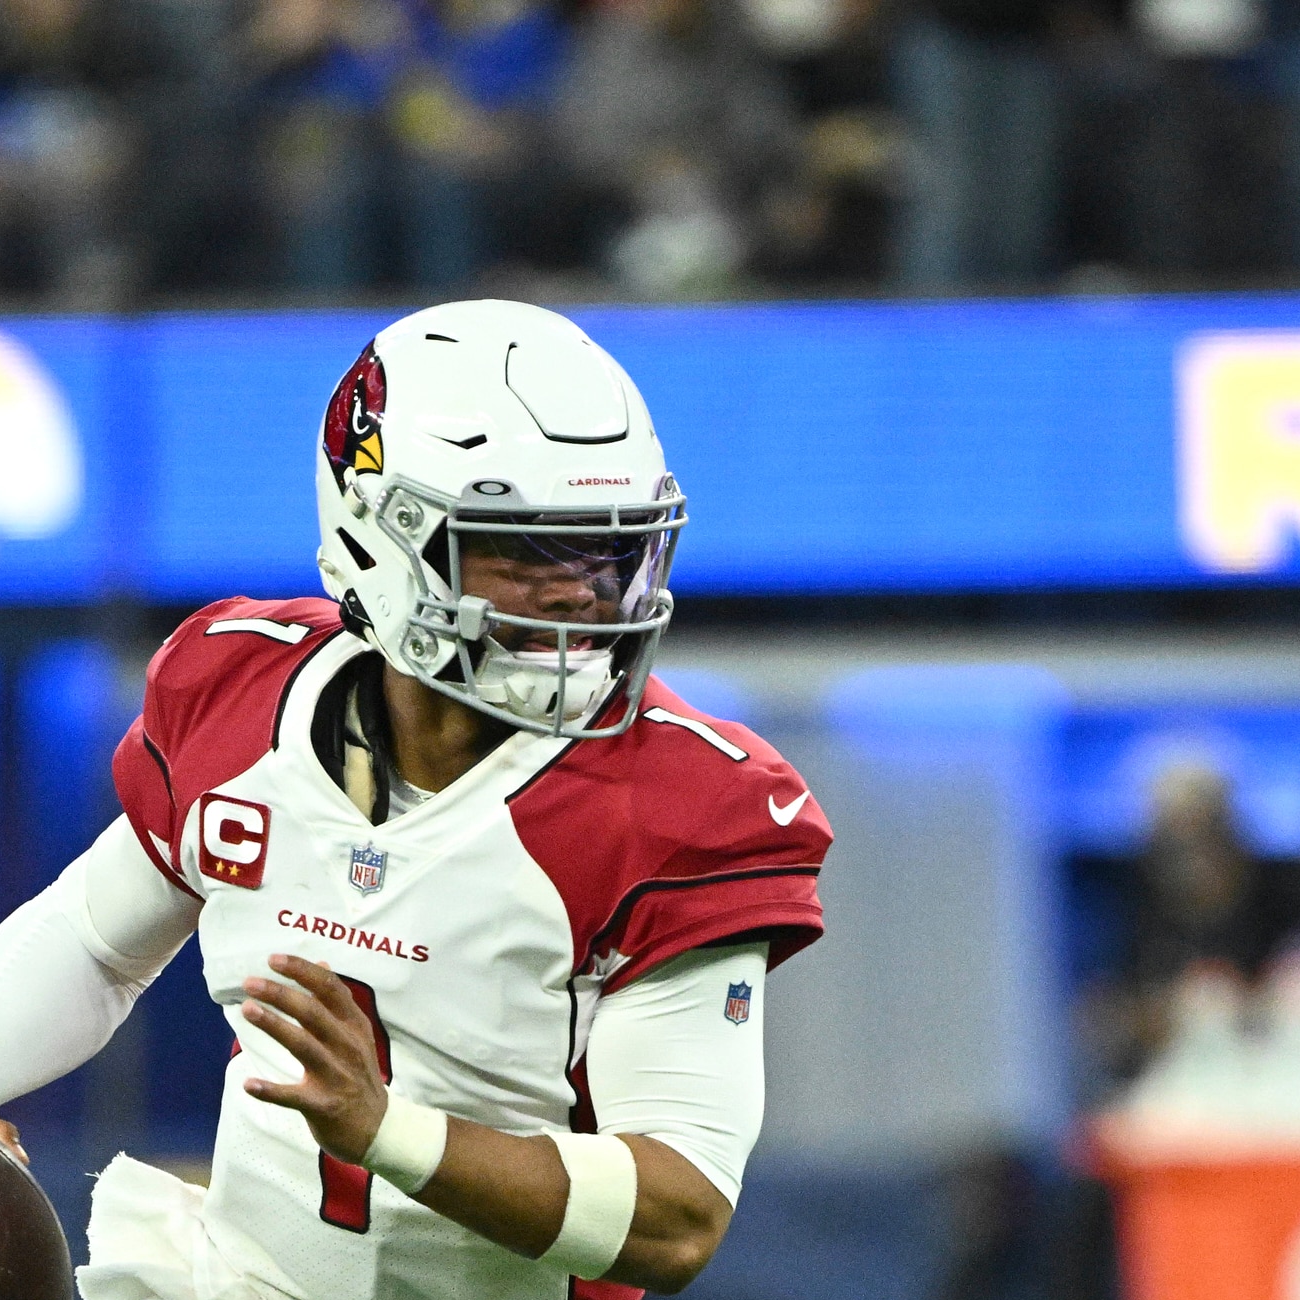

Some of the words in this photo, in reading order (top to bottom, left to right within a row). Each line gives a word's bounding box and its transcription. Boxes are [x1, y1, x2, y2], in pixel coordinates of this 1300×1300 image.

[567, 477, 631, 487] CARDINALS
[203, 799, 264, 865] C
[352, 864, 378, 887] NFL
[277, 909, 430, 963] CARDINALS
[726, 998, 748, 1020] NFL
